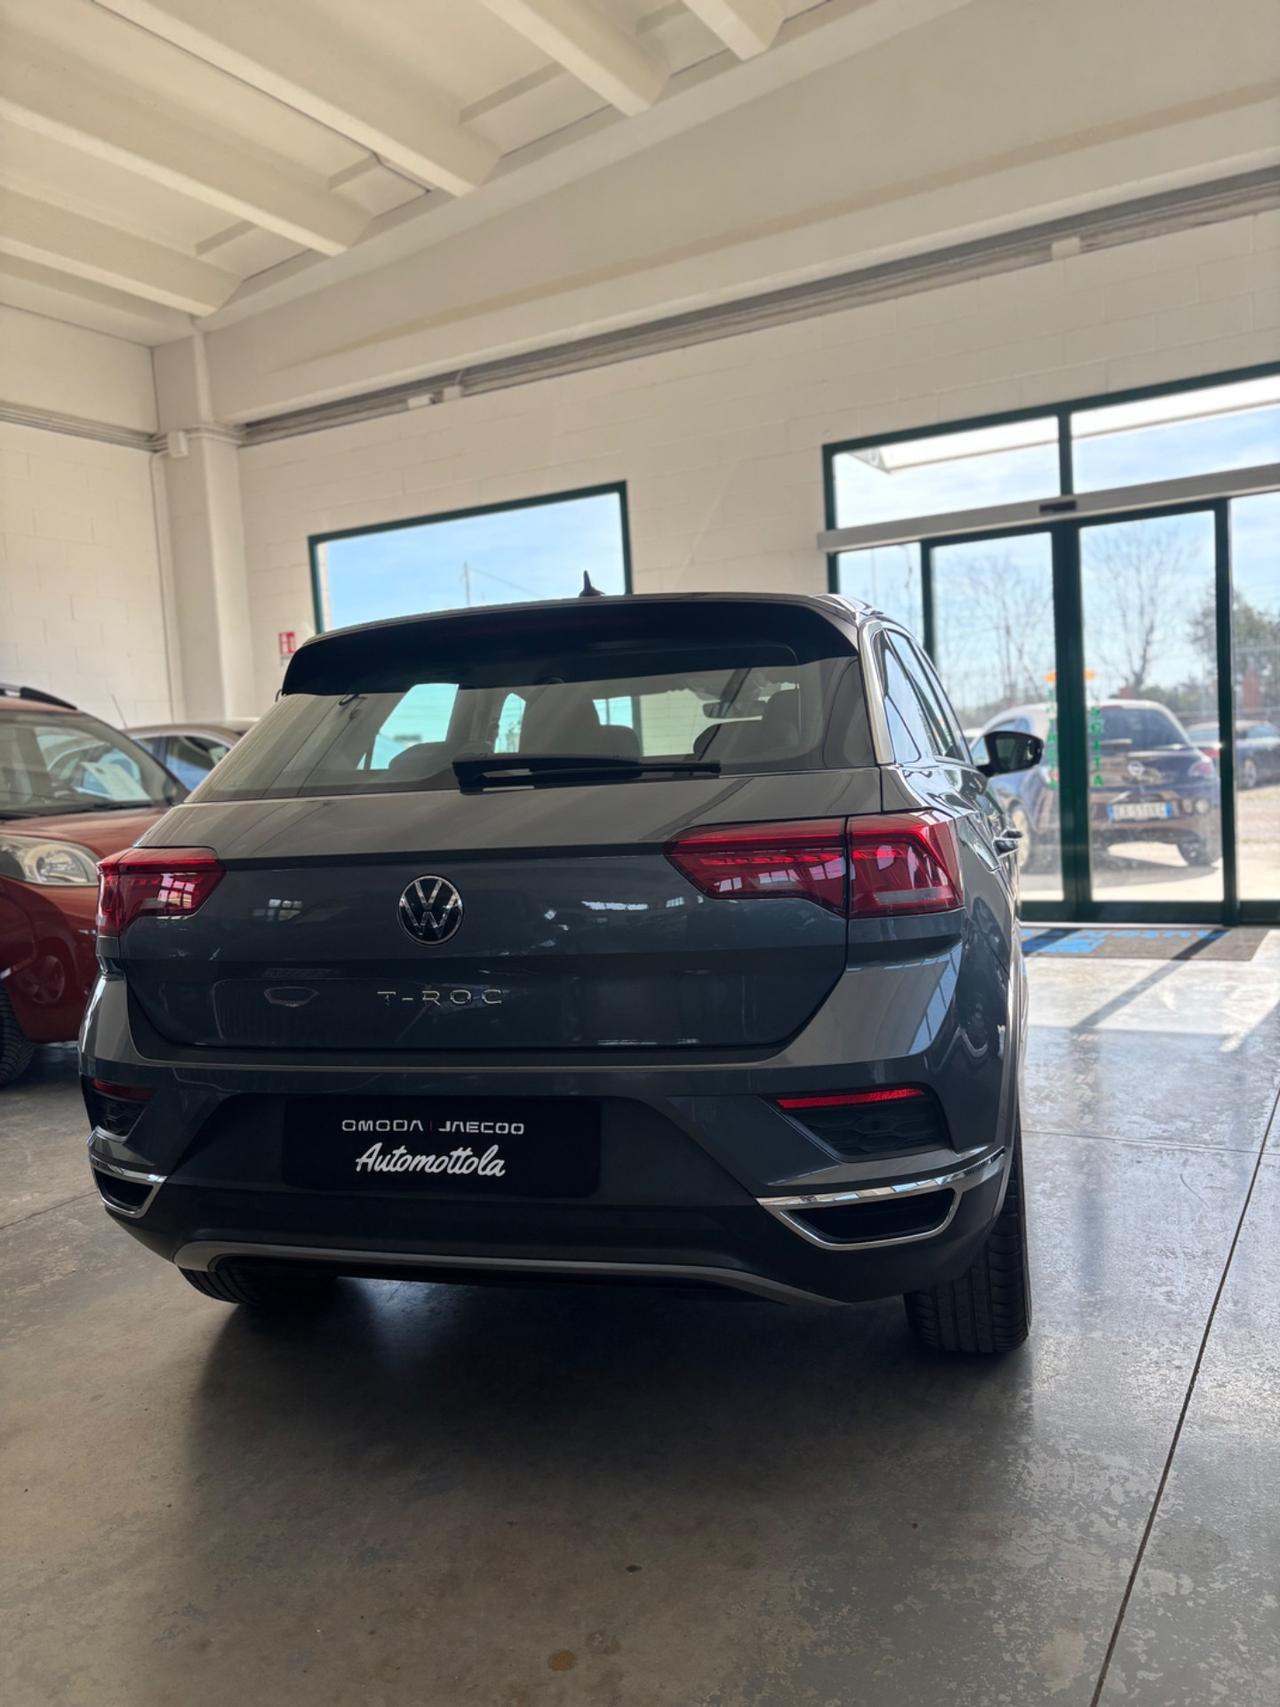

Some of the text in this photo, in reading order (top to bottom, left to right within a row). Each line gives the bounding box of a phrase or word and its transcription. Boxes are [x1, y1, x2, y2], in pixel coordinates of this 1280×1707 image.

[377, 989, 502, 1006] T-ROC
[341, 1119, 525, 1135] OMODA JAECOO
[355, 1142, 506, 1177] Automottola
